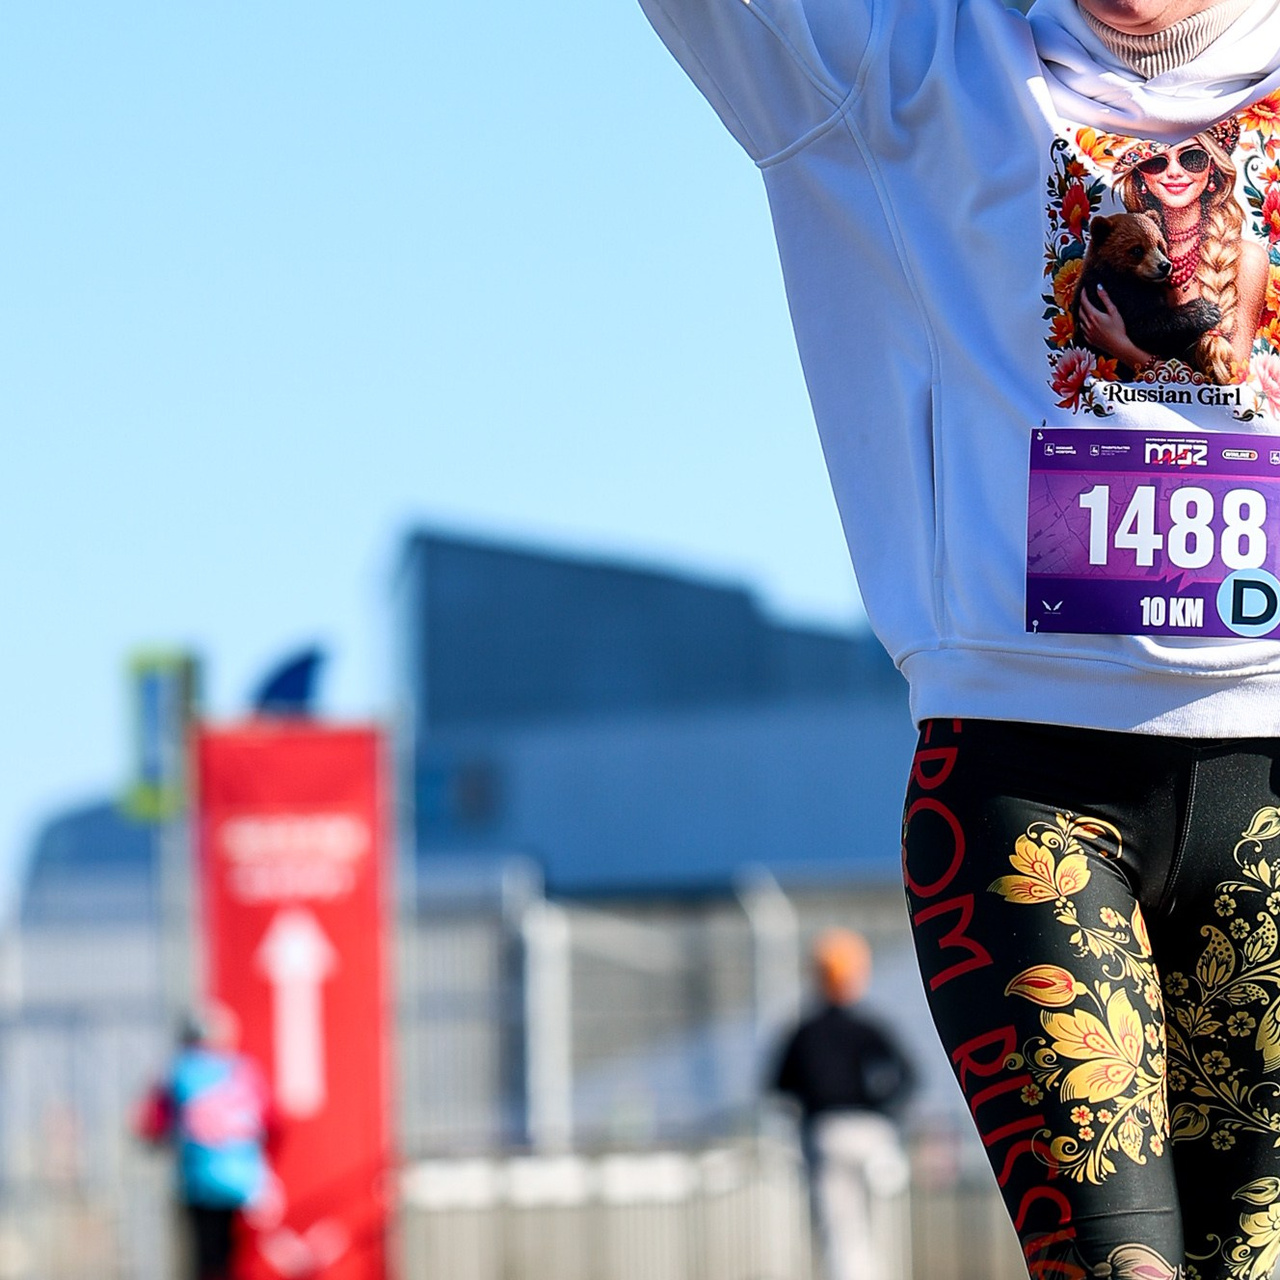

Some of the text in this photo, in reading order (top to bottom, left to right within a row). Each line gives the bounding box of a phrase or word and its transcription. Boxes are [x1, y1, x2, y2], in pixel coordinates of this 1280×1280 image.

[1102, 383, 1242, 406] Russian Girl
[1079, 485, 1267, 570] 1488
[1140, 596, 1166, 626] 10
[1231, 578, 1278, 625] D
